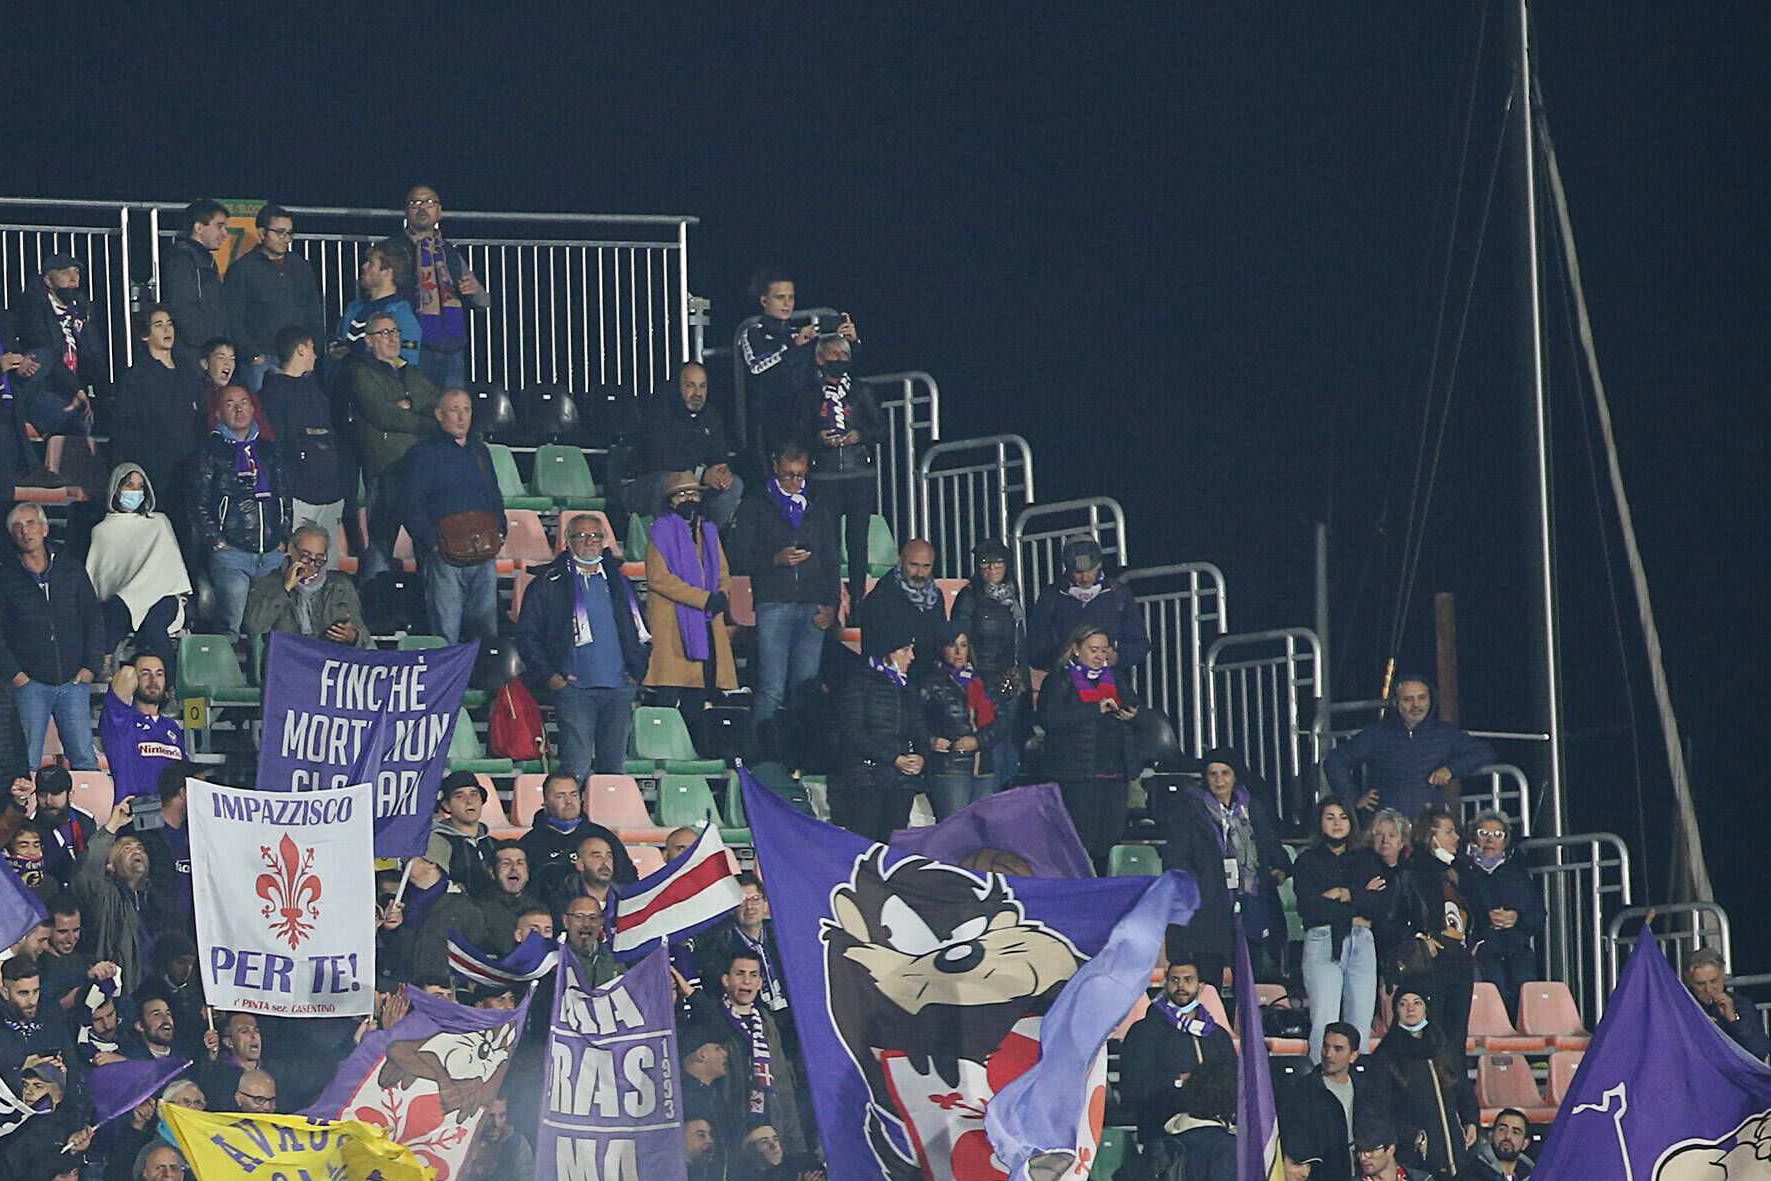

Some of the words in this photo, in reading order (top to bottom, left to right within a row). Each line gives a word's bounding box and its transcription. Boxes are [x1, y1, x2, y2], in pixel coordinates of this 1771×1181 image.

[281, 709, 374, 765] MORT
[211, 792, 354, 826] IMPAZZISCO
[210, 946, 294, 993] PER
[308, 952, 361, 994] TE!
[549, 1040, 657, 1118] RAS
[660, 1036, 677, 1120] 1993
